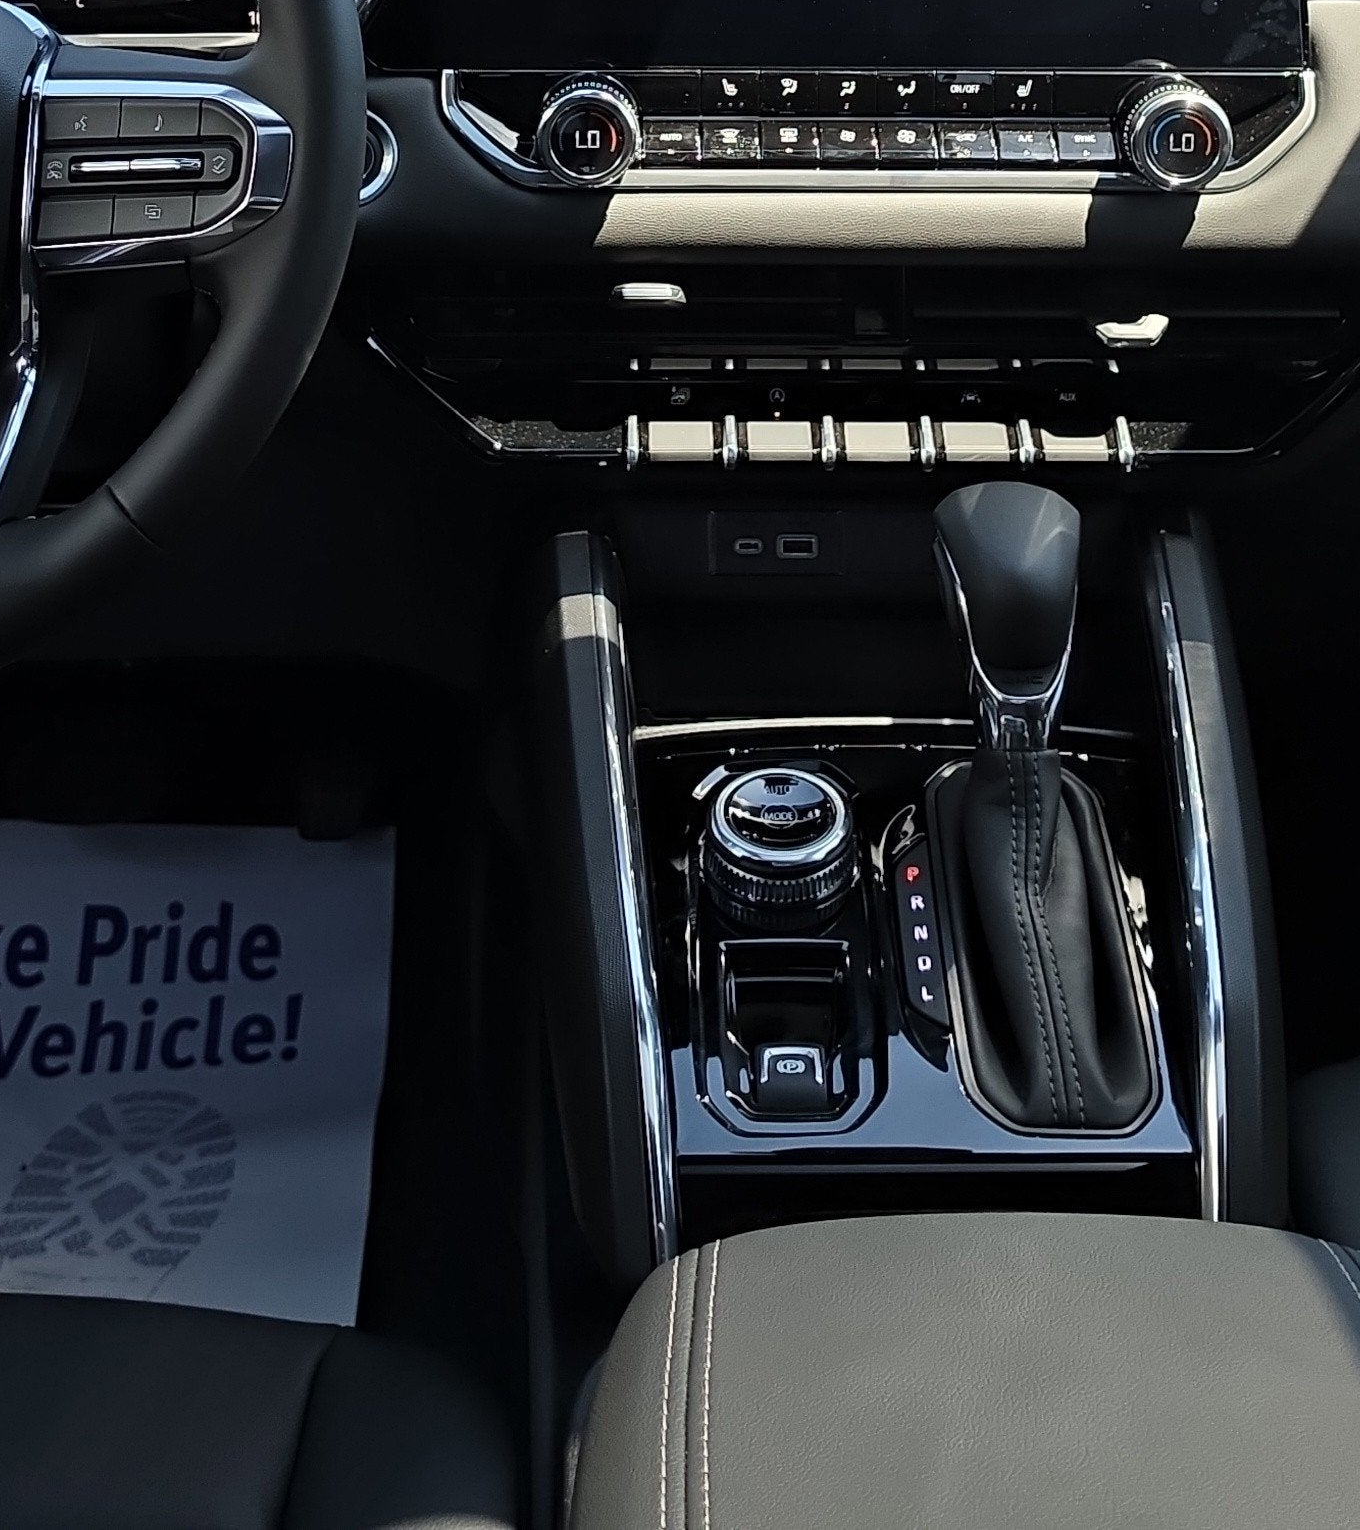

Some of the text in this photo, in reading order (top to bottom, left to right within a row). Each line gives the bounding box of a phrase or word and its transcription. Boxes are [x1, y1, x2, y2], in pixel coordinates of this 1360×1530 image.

[950, 83, 981, 95] ON/OFF
[575, 130, 600, 149] LO
[658, 132, 683, 142] AUTO
[1016, 134, 1035, 144] A/C
[1168, 132, 1195, 153] LO
[1058, 391, 1078, 403] AUX
[764, 785, 791, 796] AUTO
[764, 811, 794, 821] MODE
[906, 866, 920, 882] P
[910, 895, 925, 910] R
[914, 925, 929, 941] N
[74, 899, 282, 986] Pride
[918, 955, 932, 971] D
[921, 986, 935, 1002] L
